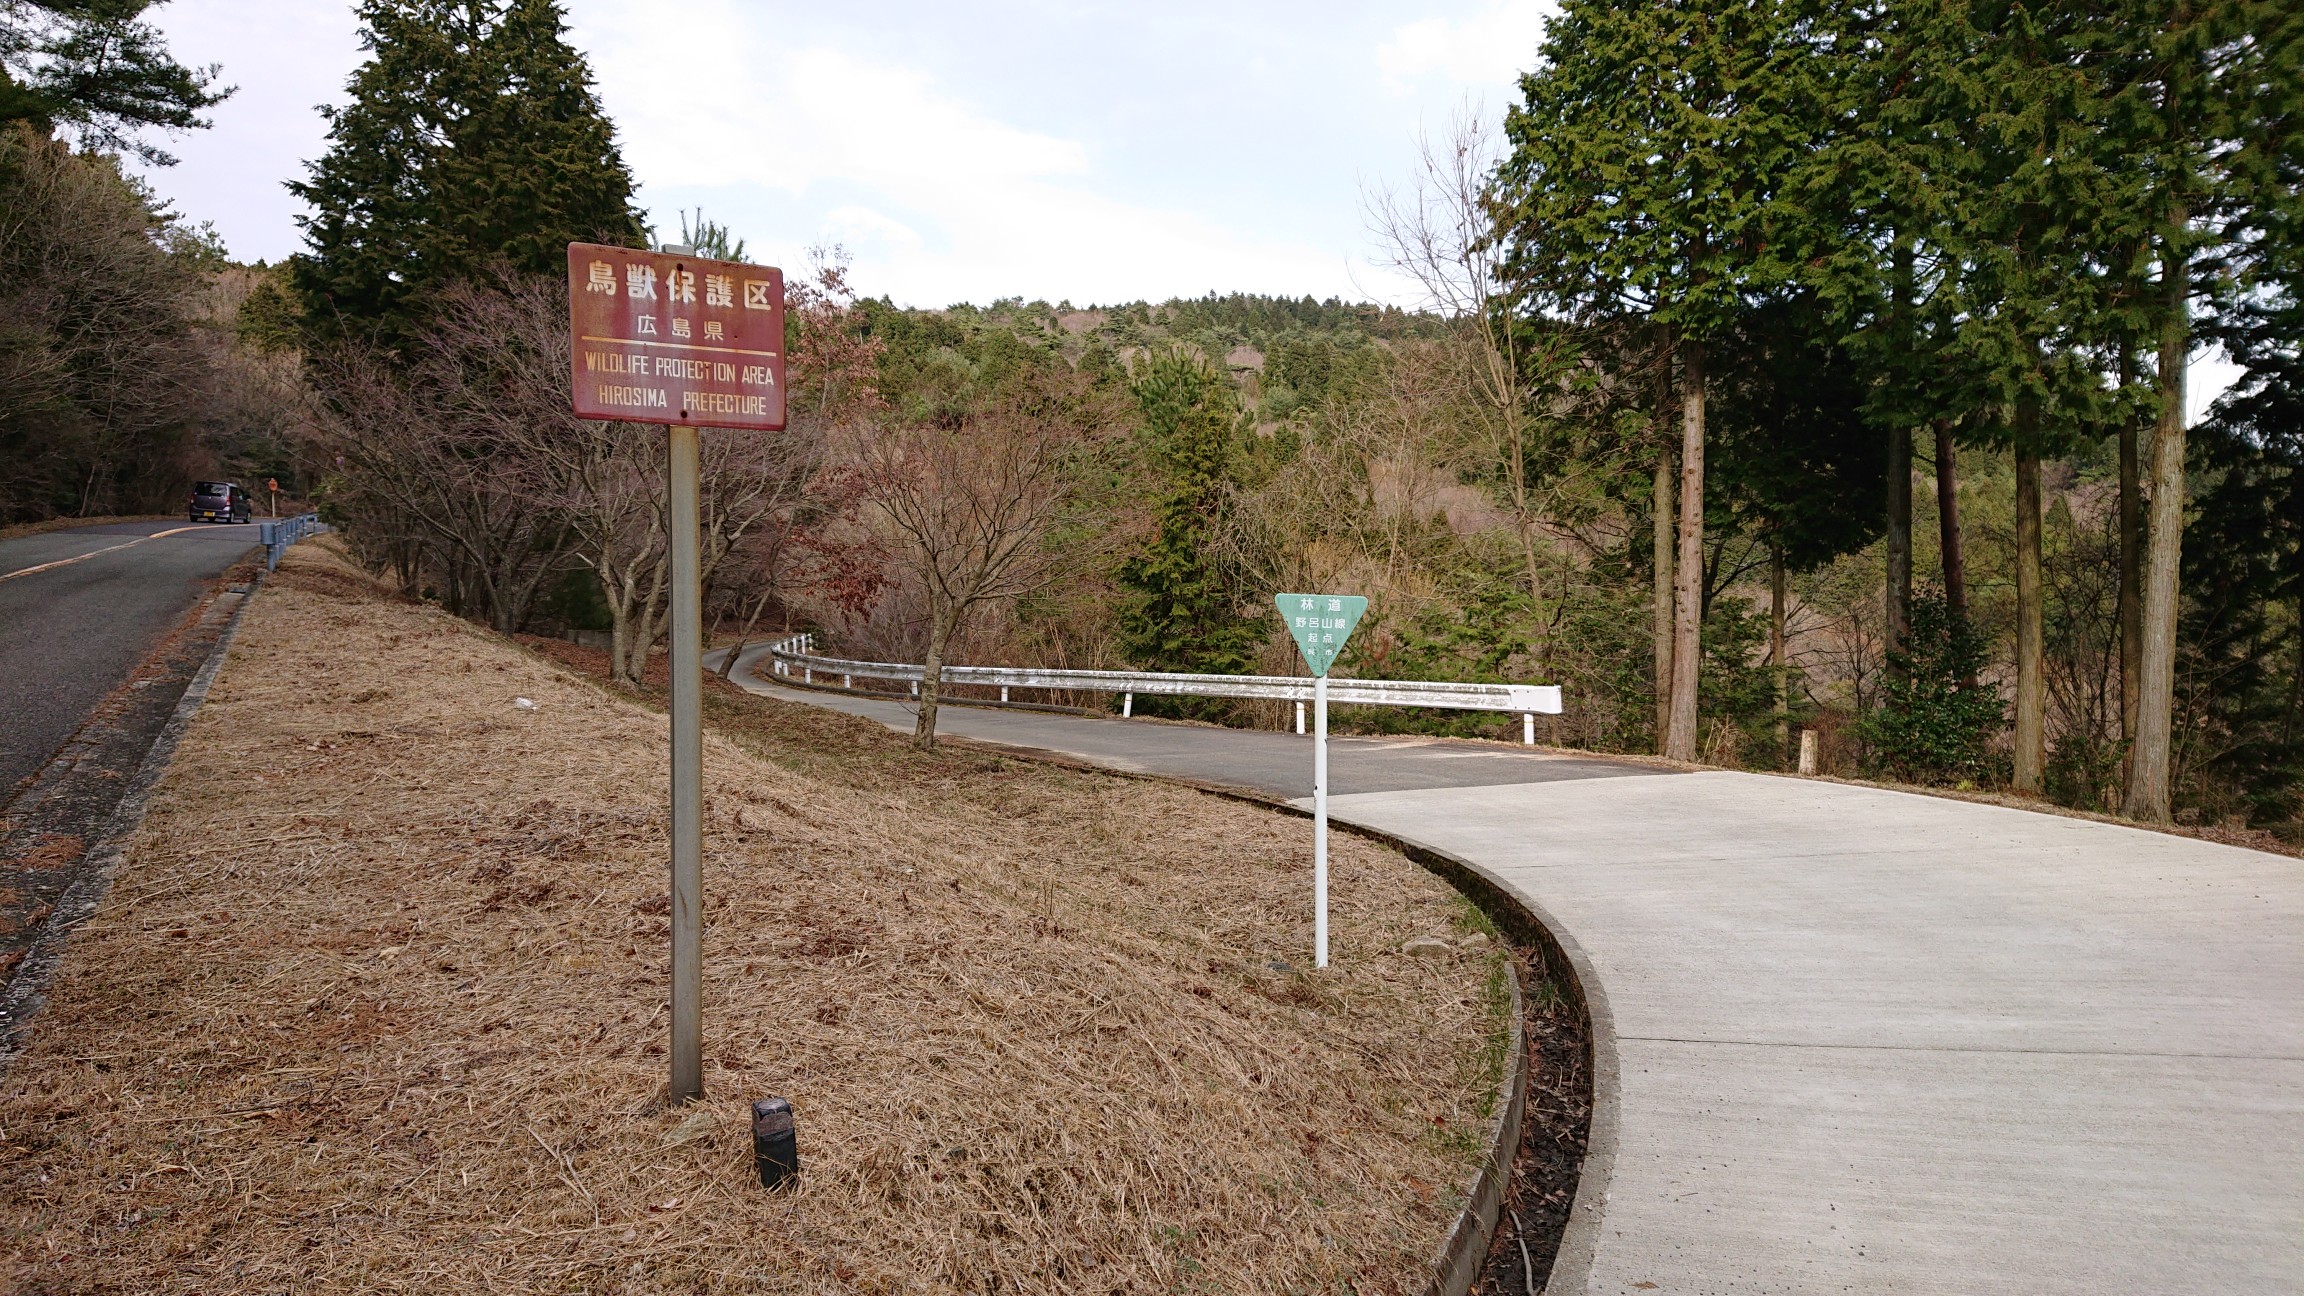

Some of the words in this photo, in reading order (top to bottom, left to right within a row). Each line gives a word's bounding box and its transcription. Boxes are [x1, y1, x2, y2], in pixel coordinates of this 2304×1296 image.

[586, 260, 772, 311] 鳥獣保護区
[637, 314, 724, 341] 広島県
[585, 350, 649, 376] WILDLIFE
[655, 357, 736, 384] PROTECTION
[741, 366, 774, 386] AREA
[598, 384, 668, 408] HIROSIMA
[682, 391, 767, 416] PREFECTURE
[1300, 597, 1342, 612] 林道
[1295, 616, 1346, 629] 野呂山線
[1307, 632, 1333, 644] 起点
